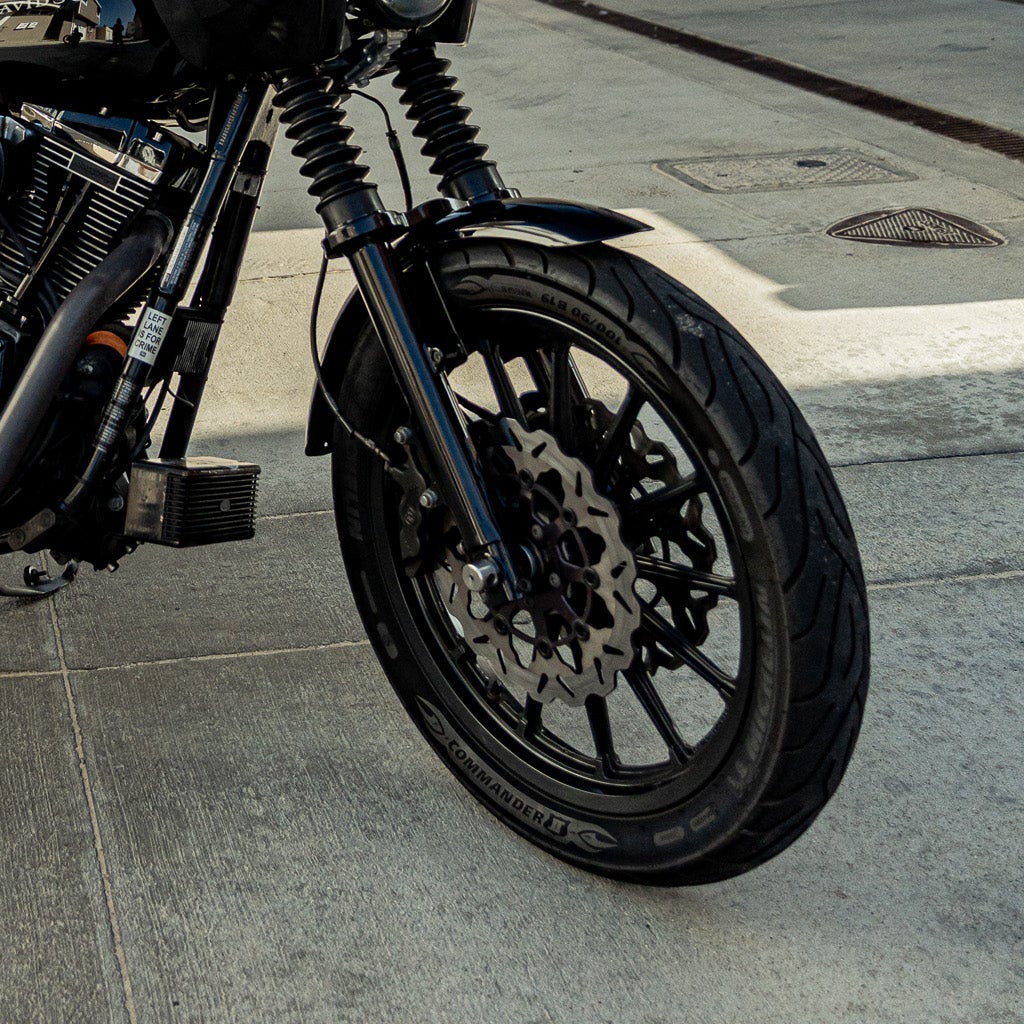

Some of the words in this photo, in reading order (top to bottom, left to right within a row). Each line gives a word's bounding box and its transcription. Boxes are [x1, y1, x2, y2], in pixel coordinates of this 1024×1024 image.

[147, 311, 167, 326] LEFT
[143, 320, 164, 336] LANE
[138, 329, 145, 338] IS
[145, 332, 162, 345] FOR
[134, 339, 158, 355] CRIME
[447, 738, 546, 826] COMMANDER
